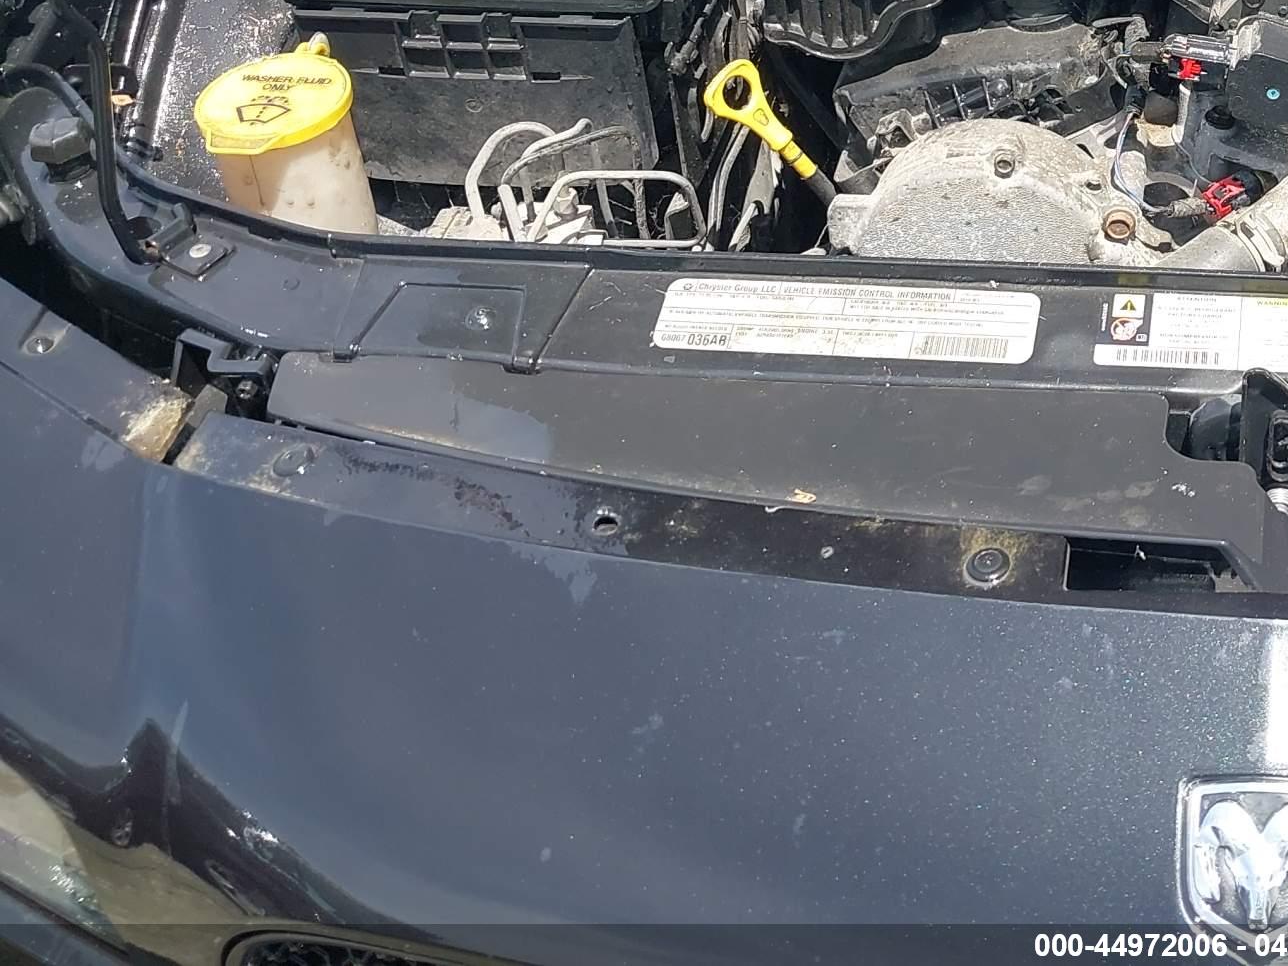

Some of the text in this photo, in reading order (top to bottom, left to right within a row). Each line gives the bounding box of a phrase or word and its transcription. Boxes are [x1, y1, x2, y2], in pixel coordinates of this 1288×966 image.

[242, 74, 333, 84] WASHER FLUID
[698, 282, 777, 294] Chrysler Group LLC
[783, 285, 816, 295] VEHICLE
[818, 287, 857, 297] EMISSION
[859, 288, 895, 298] CONTROL
[897, 291, 951, 301] INFORMATION
[687, 333, 727, 347] 036AB
